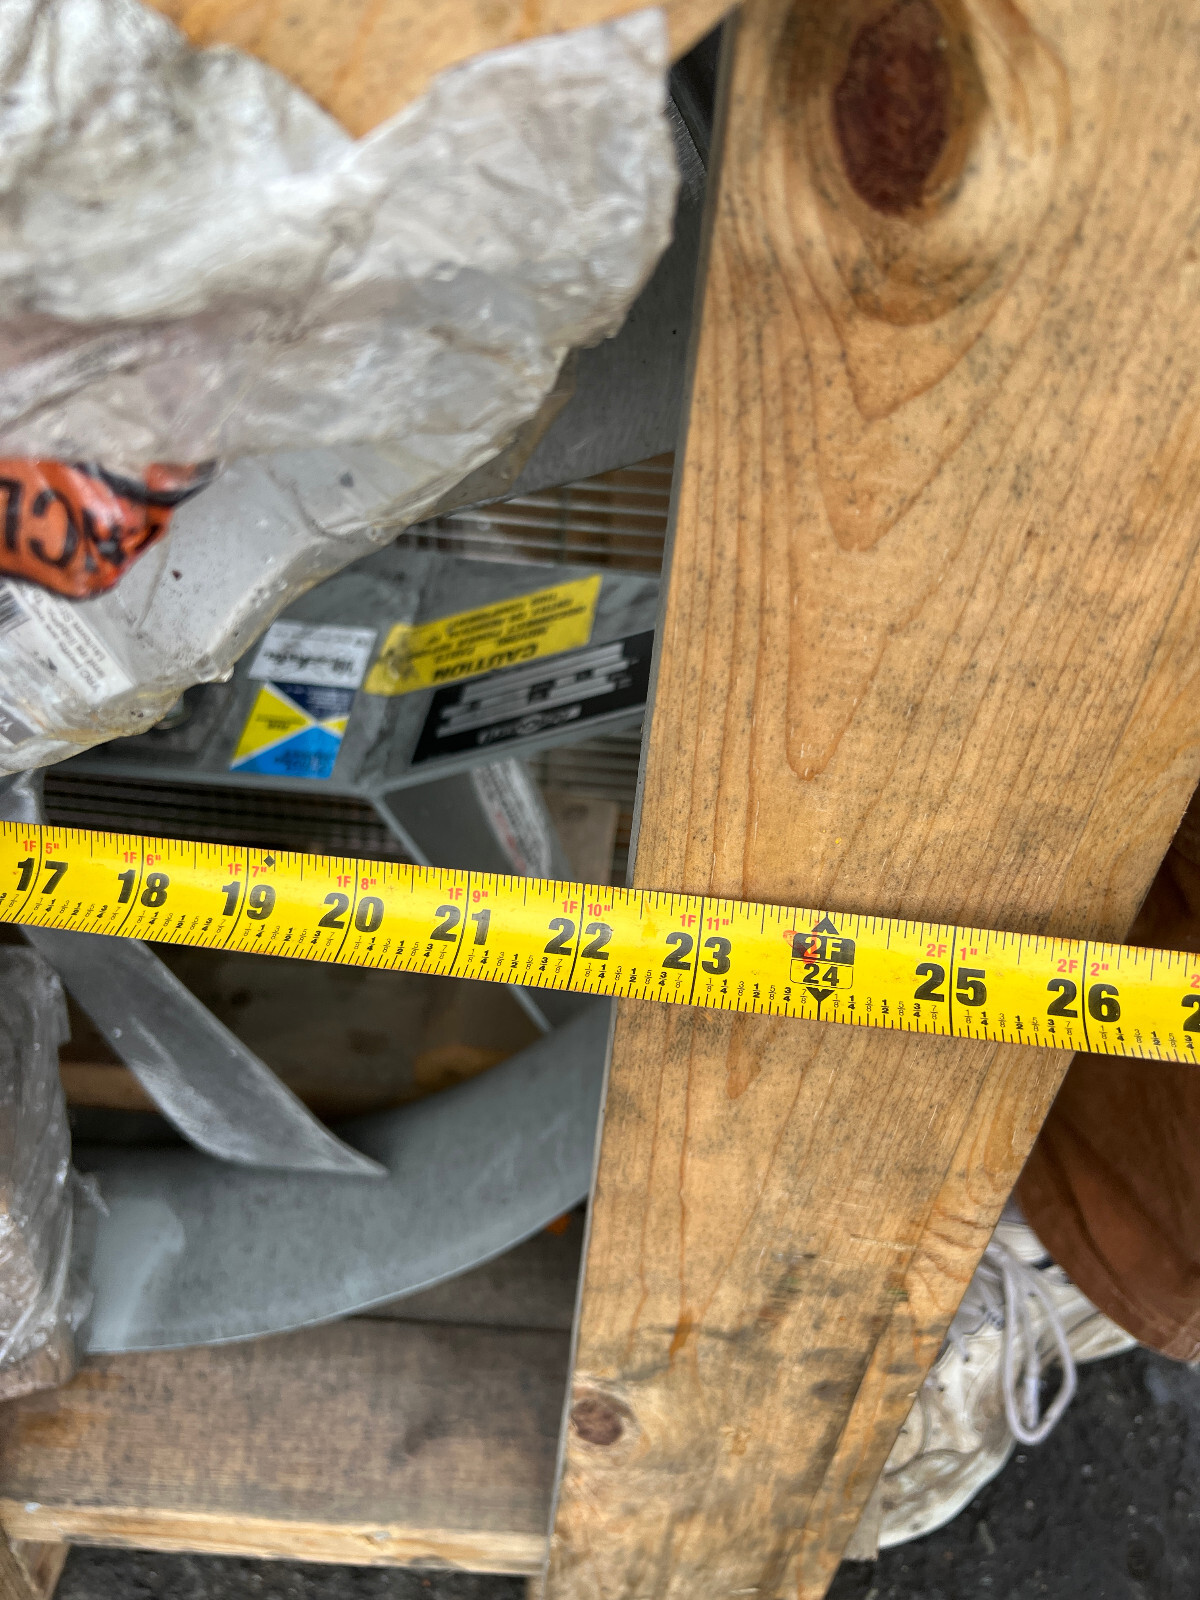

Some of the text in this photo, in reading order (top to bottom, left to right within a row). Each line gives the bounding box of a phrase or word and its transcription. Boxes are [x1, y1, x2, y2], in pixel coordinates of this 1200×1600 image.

[432, 643, 539, 682] CAUTION
[22, 840, 37, 852] 1F
[123, 851, 137, 864] 1F
[16, 857, 69, 895] 17
[227, 863, 242, 876] 1F
[336, 875, 351, 888] 1F
[117, 869, 170, 908] 18
[221, 880, 276, 921] 19
[447, 887, 463, 900] 1F
[317, 892, 385, 933] 20
[562, 900, 578, 914] 1F
[430, 904, 491, 946] 21
[679, 914, 697, 928] 1F
[543, 917, 613, 961] 22
[803, 936, 843, 960] 2F
[926, 943, 947, 958] 2F
[662, 931, 732, 975] 23
[802, 963, 840, 987] 24
[1057, 959, 1078, 973] 2F
[914, 962, 987, 1007] 25
[1046, 978, 1121, 1023] 26
